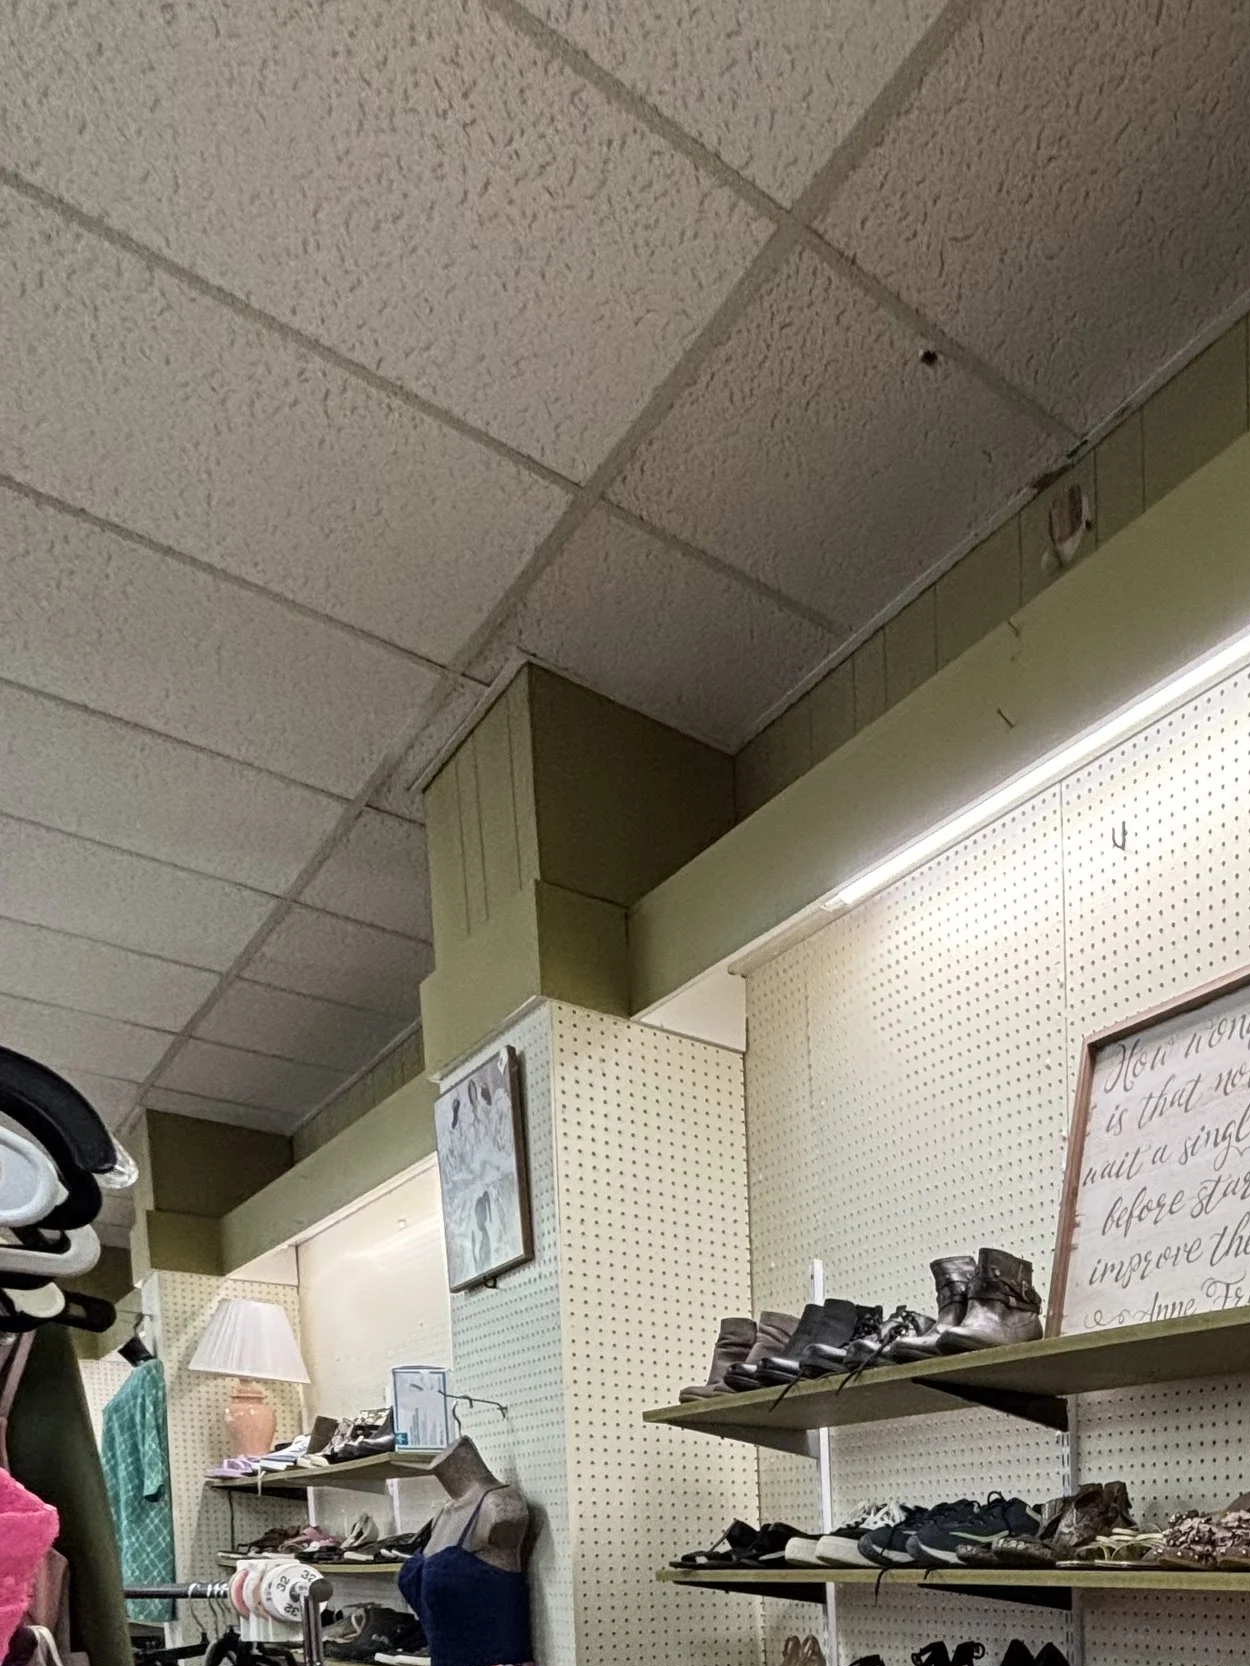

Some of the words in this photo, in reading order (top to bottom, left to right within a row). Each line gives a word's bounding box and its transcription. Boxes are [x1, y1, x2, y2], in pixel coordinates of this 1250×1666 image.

[1105, 1104, 1125, 1137] is
[1137, 1074, 1203, 1130] that
[1082, 1146, 1144, 1188] wait
[1151, 1143, 1170, 1166] a
[1101, 1187, 1185, 1238] before
[1089, 1235, 1206, 1289] improve
[277, 1576, 290, 1592] 32
